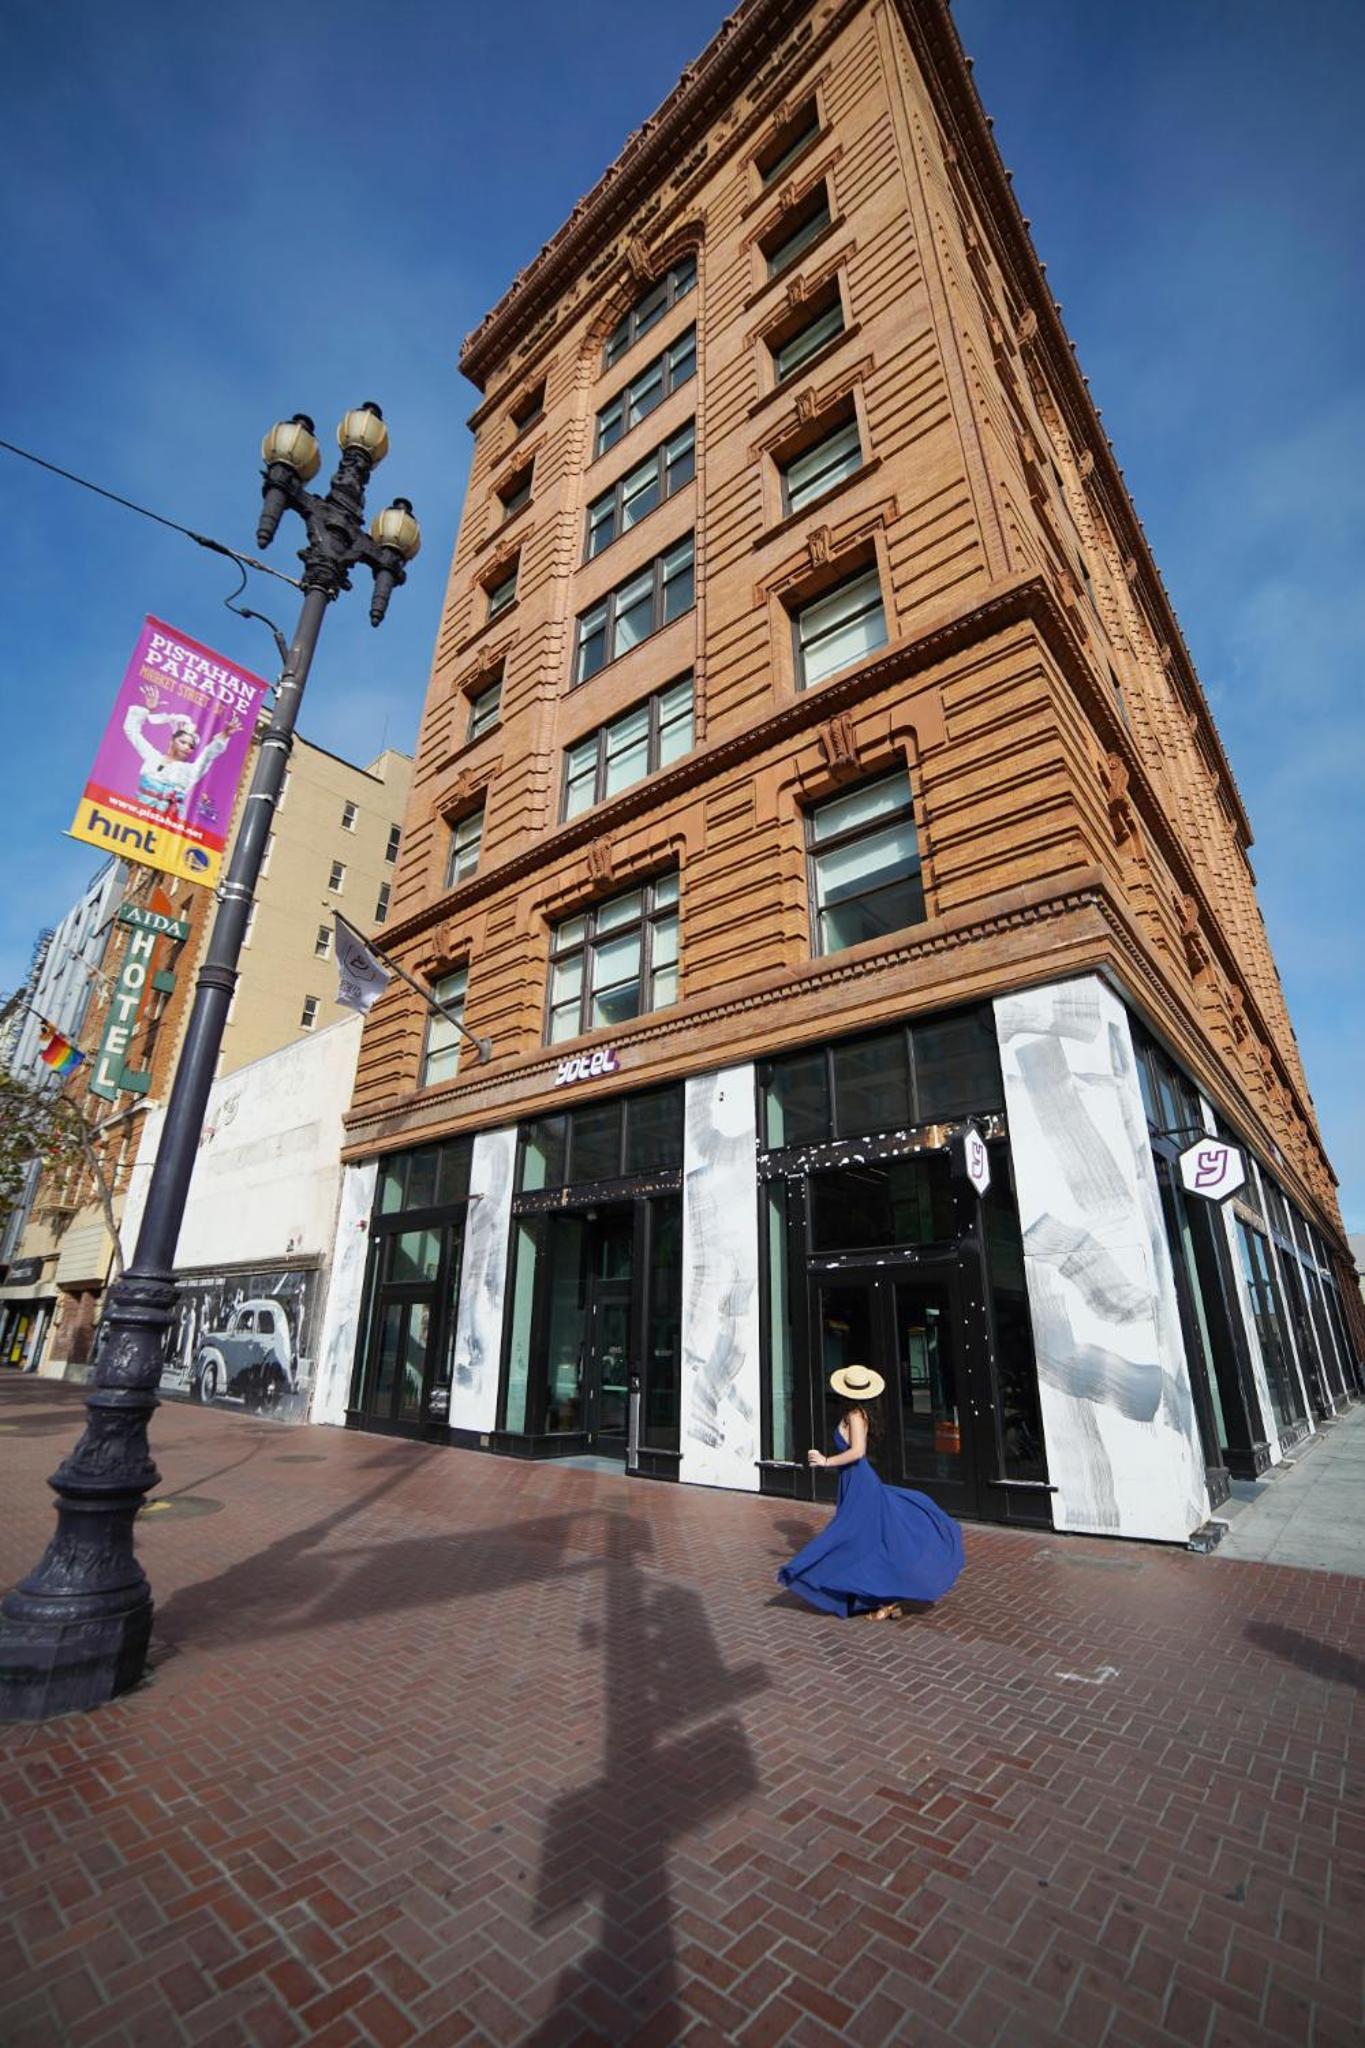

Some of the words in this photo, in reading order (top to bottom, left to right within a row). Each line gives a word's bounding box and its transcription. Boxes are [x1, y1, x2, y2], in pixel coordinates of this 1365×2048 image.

[144, 648, 251, 715] PARADE
[150, 633, 257, 701] PISTAHAN
[87, 808, 158, 854] hint
[108, 796, 204, 840] www.pistahan.net
[126, 907, 182, 937] AIDA
[97, 930, 156, 1087] HOTEL
